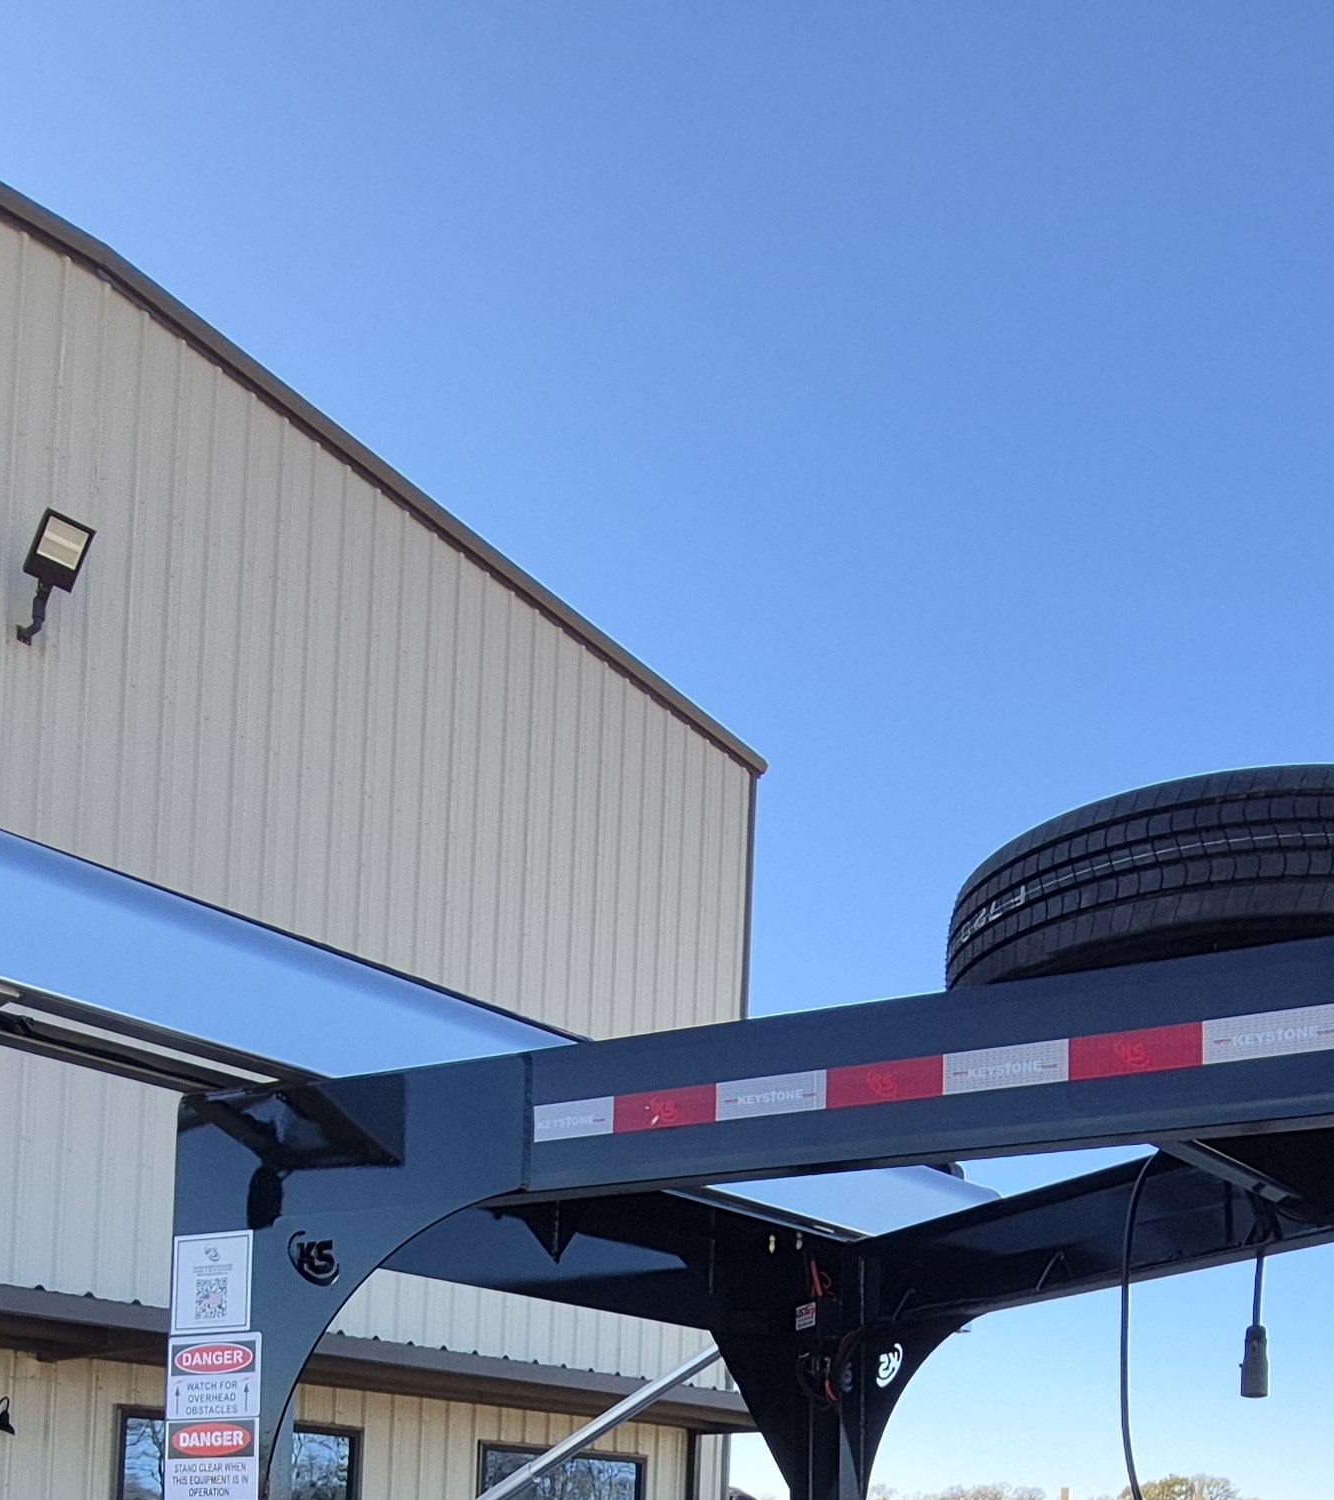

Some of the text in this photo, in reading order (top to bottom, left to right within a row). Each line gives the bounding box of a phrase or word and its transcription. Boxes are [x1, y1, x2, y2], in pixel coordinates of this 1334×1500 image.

[1232, 1024, 1318, 1046] KEYSTONE
[968, 1060, 1042, 1079] KEYSTONE
[737, 1088, 803, 1106] KEYSTONE
[537, 1114, 594, 1129] KEYSTONE
[182, 1350, 243, 1366] DANGER
[187, 1381, 238, 1391] WATCH FOR
[187, 1393, 236, 1403] OVERHEAD
[186, 1405, 238, 1415] OBSTACLES
[179, 1430, 243, 1447] DANGER
[174, 1462, 246, 1473] STAND CLEAR WHEN
[173, 1475, 248, 1485] THIS EQUIPMENT IS IN
[189, 1488, 229, 1497] OPERATION
